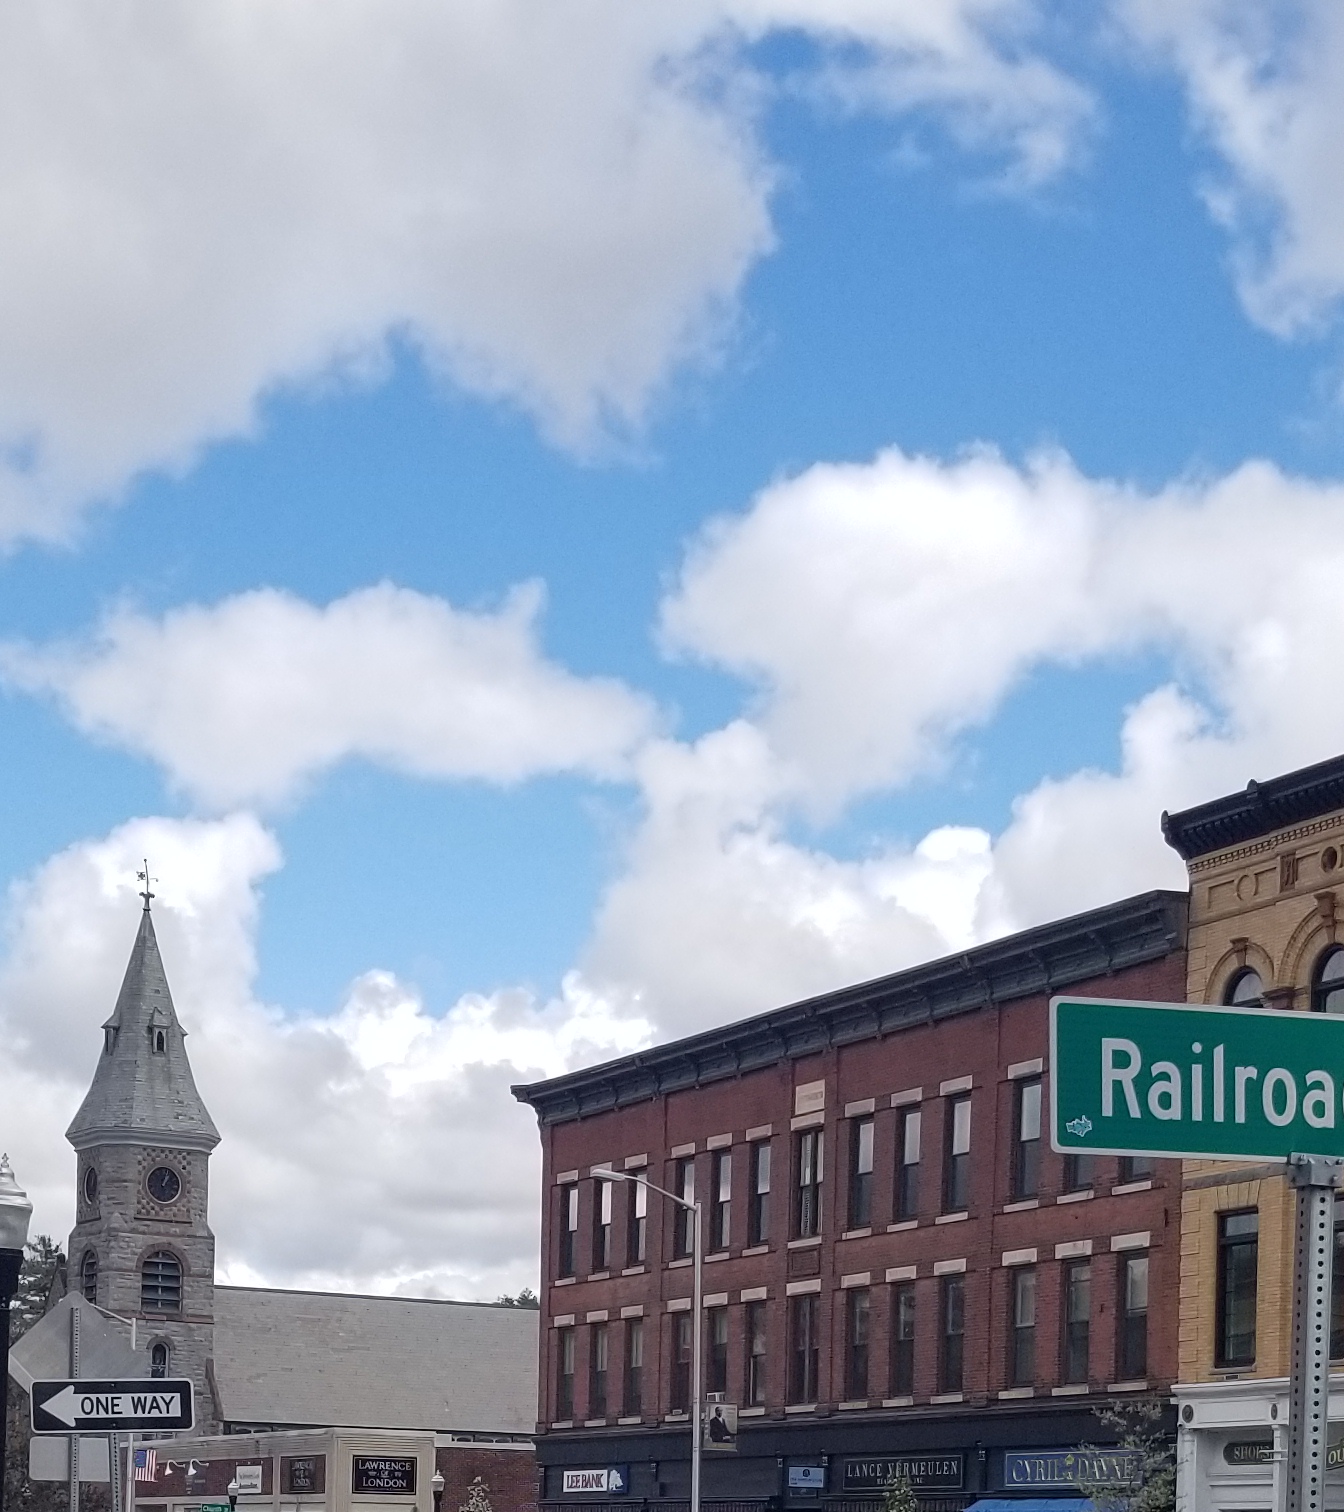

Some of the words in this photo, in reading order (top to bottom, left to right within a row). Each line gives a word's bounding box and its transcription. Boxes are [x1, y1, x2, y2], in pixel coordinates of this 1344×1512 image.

[80, 1396, 123, 1415] ONE
[131, 1395, 176, 1415] WAY
[358, 1459, 412, 1471] LAWRENCE
[847, 1462, 882, 1477] LANCE
[1012, 1459, 1064, 1482] CYRIL
[362, 1476, 407, 1488] LONDON
[566, 1474, 581, 1489] LEE
[581, 1473, 605, 1489] BANK
